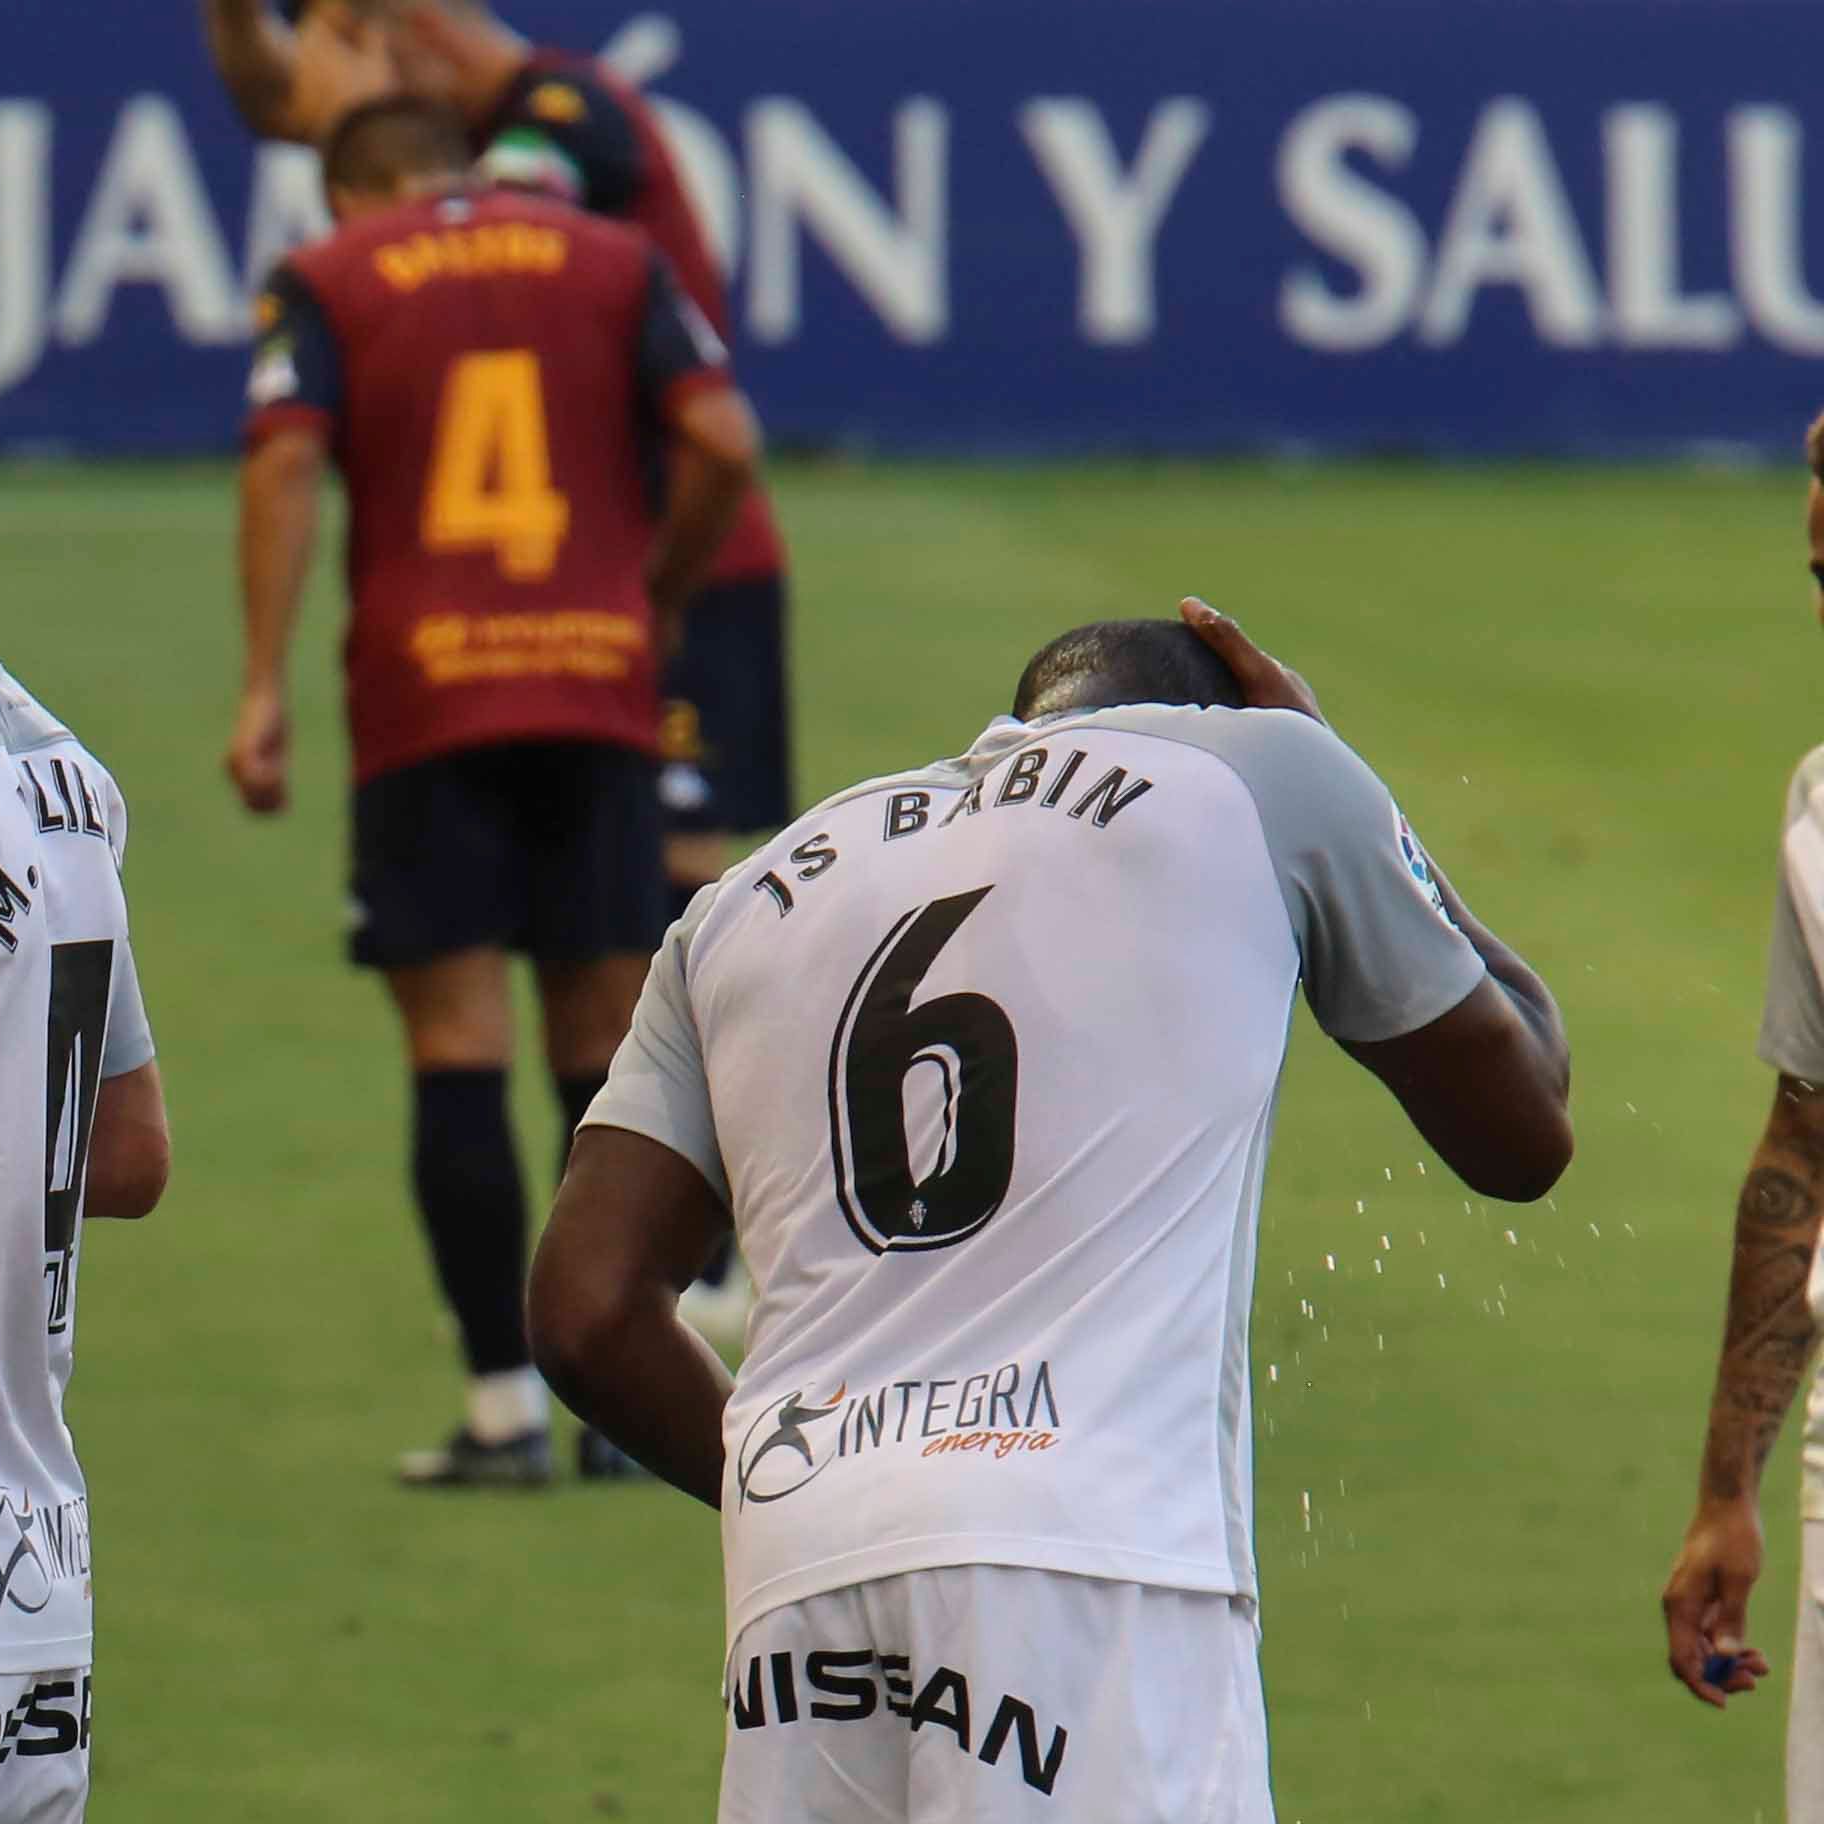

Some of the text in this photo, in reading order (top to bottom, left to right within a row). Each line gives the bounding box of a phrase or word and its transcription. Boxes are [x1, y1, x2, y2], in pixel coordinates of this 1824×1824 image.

[1017, 95, 1212, 347] Y
[419, 348, 572, 580] 4
[753, 832, 837, 918] JS
[42, 938, 115, 1335] 4
[828, 884, 1018, 1257] 6
[838, 1361, 1061, 1457] INTEGRA
